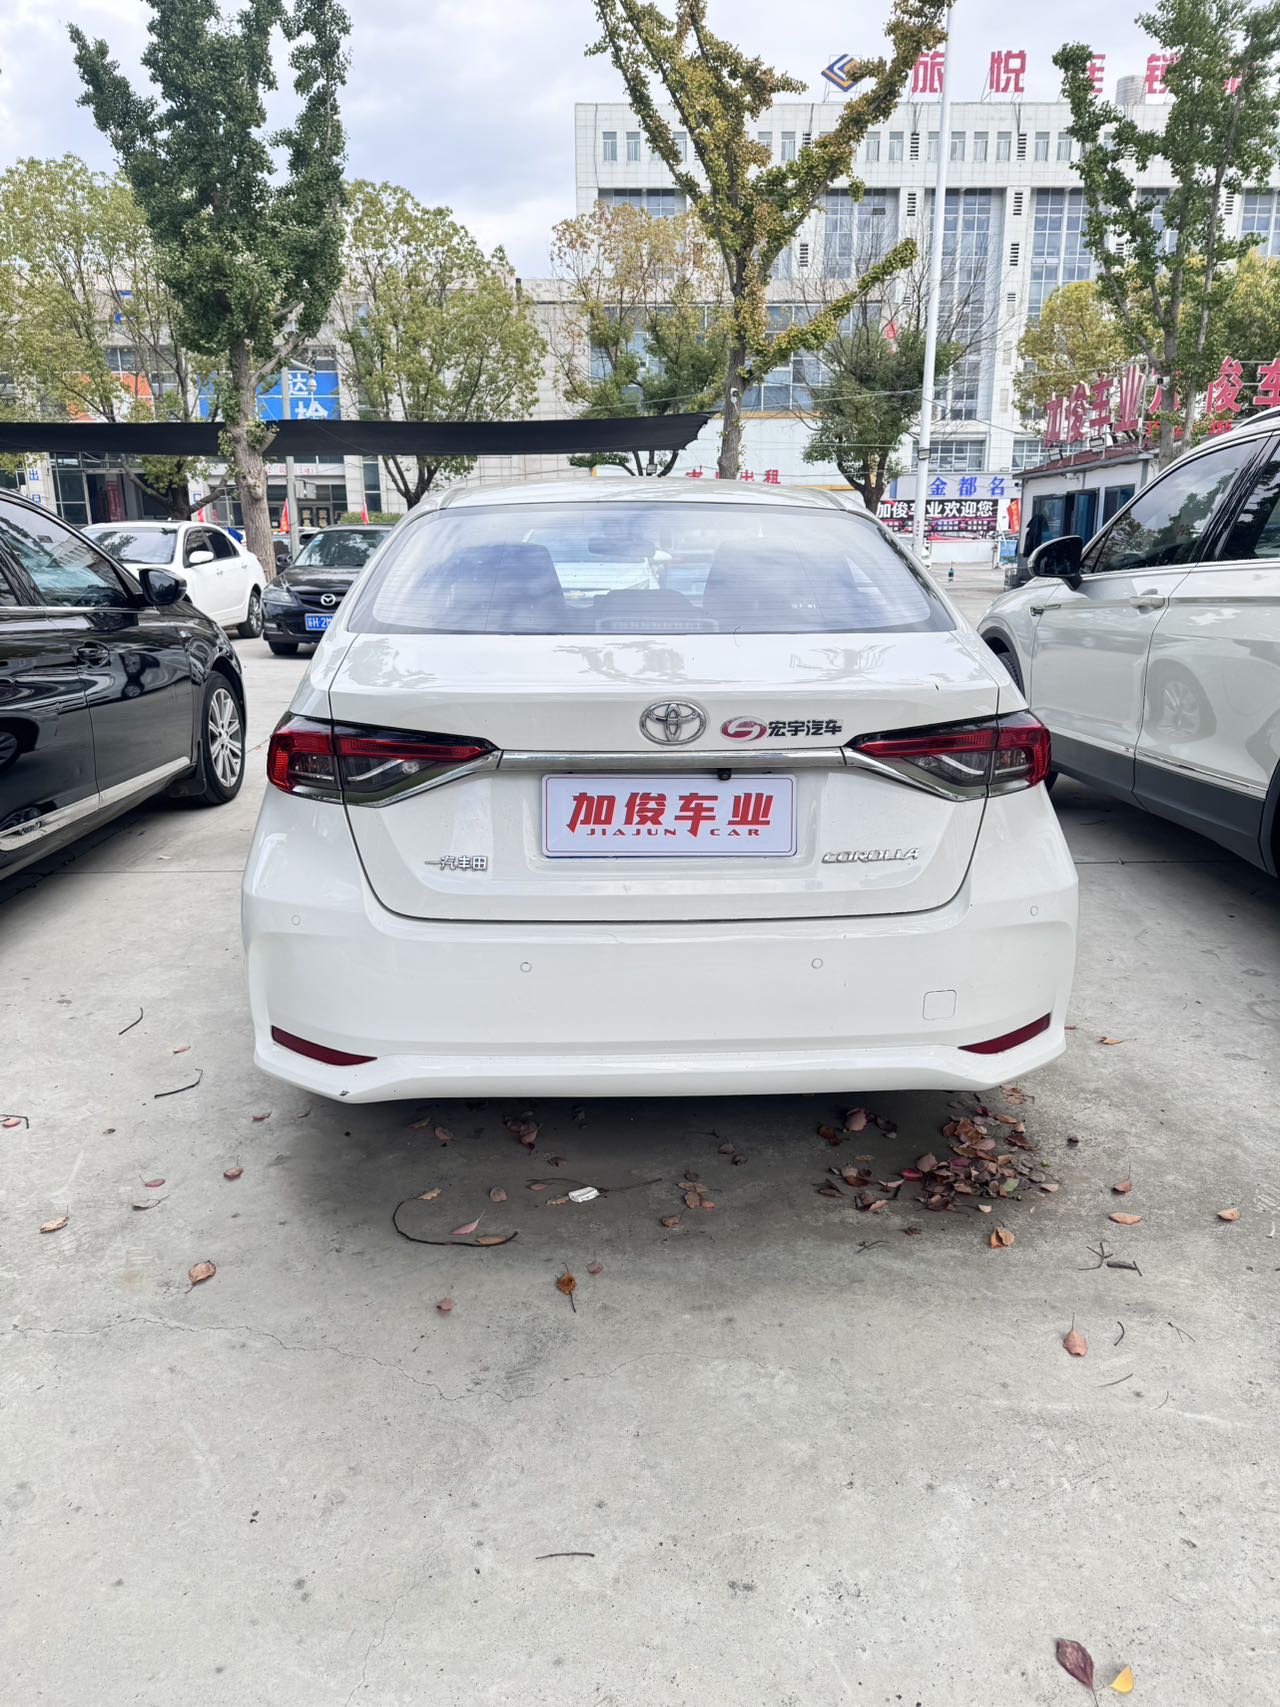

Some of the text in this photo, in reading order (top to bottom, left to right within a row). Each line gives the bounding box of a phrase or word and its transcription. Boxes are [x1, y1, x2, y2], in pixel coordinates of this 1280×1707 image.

[768, 720, 842, 737] 宏宇汽车
[566, 792, 773, 838] 加俊车业
[586, 828, 760, 836] JIAJUN CAR
[424, 855, 488, 872] 一汽丰田
[821, 848, 919, 864] COROLLA
